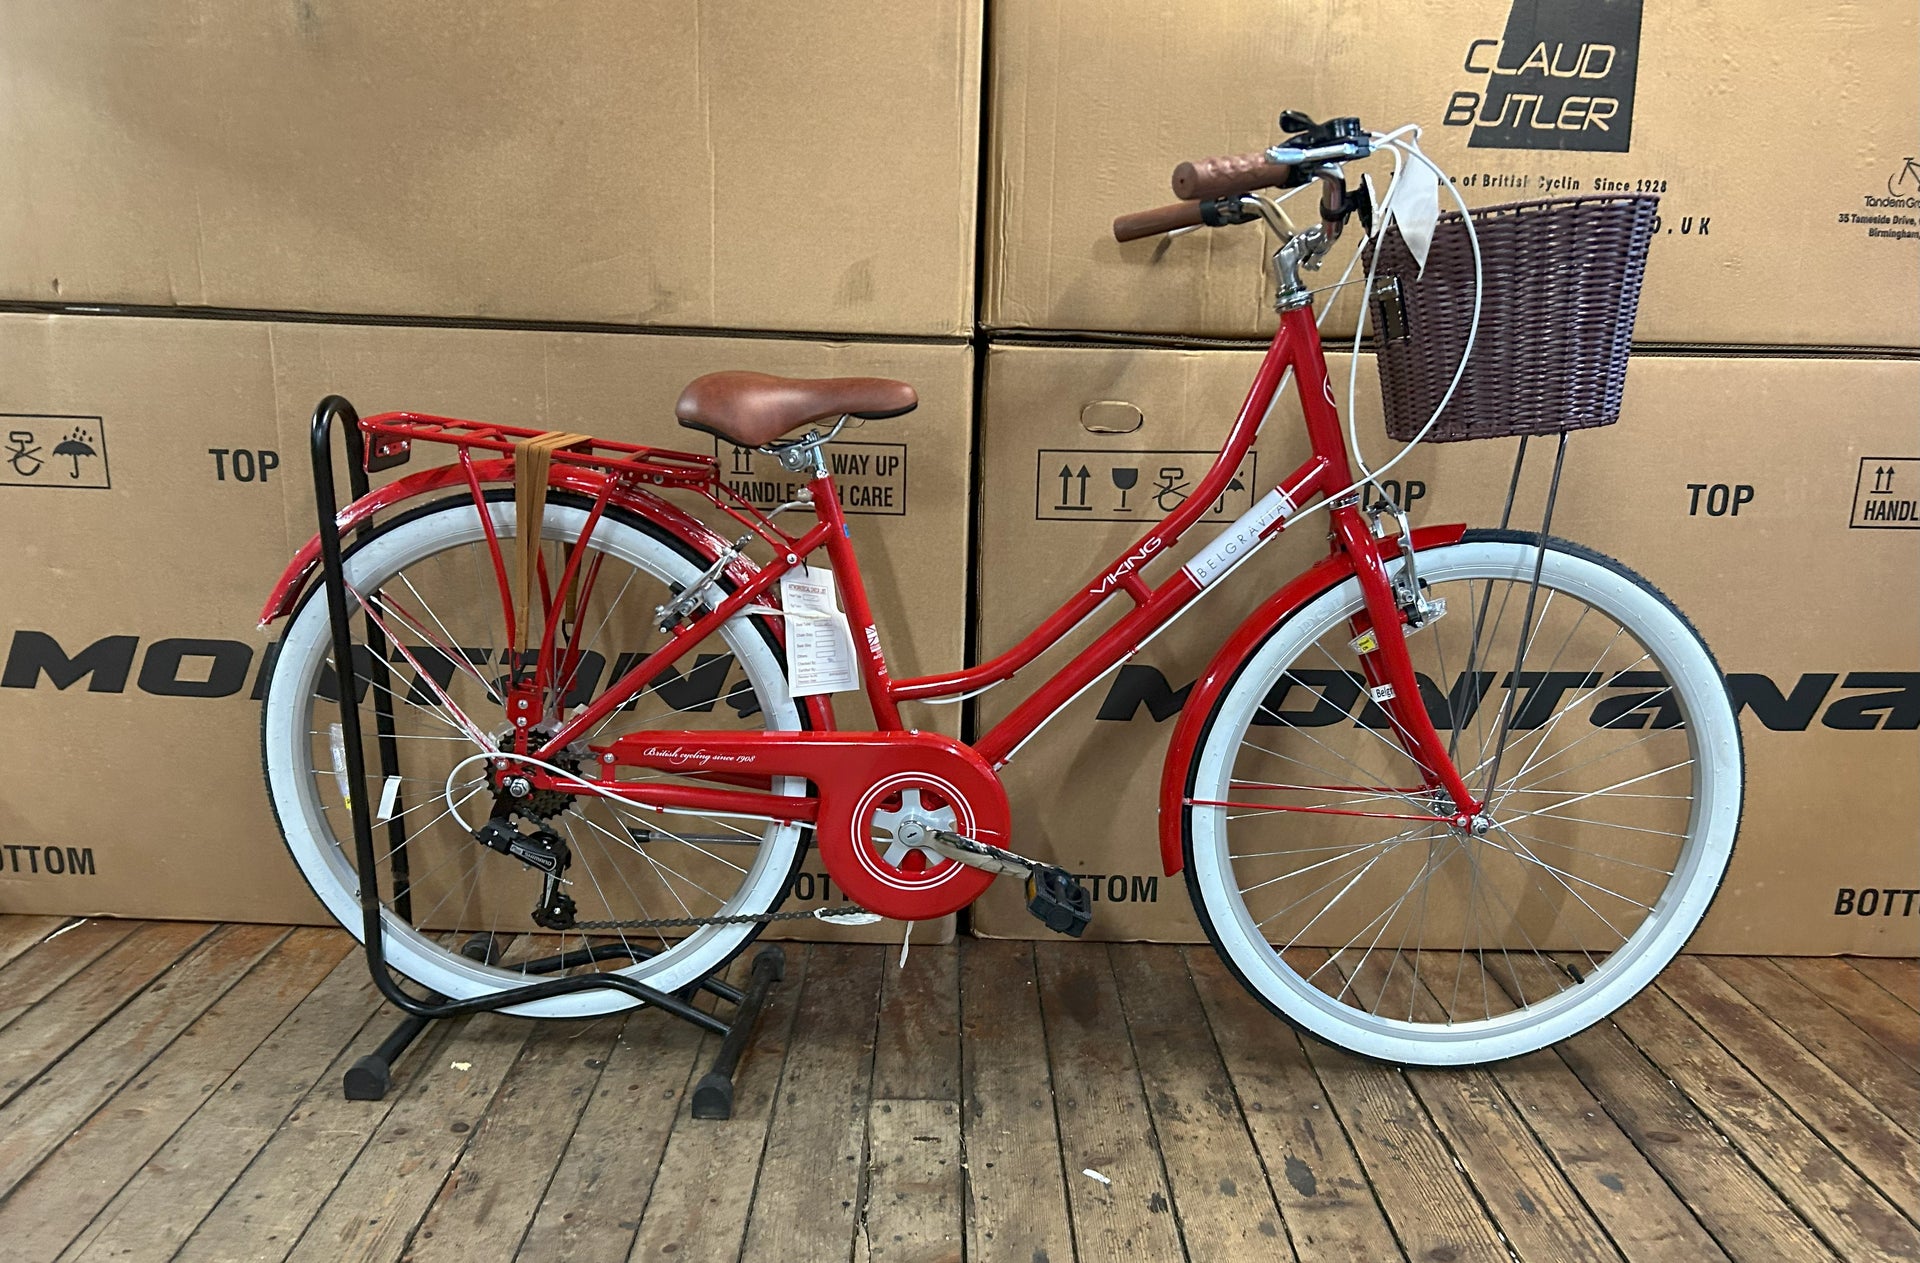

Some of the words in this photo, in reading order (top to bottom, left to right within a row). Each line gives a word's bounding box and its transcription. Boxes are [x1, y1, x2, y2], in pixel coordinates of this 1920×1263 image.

[1464, 39, 1616, 79] CLAUD
[1442, 91, 1619, 132] BUTLER
[1463, 173, 1477, 187] of
[1594, 177, 1630, 191] Since
[1636, 179, 1668, 193] 1928
[1864, 195, 1905, 208] Tandem
[1838, 213, 1850, 223] 35
[1851, 213, 1891, 225] Tameside
[1892, 215, 1917, 227] Drive,
[208, 448, 280, 483] TOP
[831, 453, 870, 476] WAY
[876, 456, 899, 477] UP
[728, 480, 796, 503] HANDLE
[850, 486, 894, 507] CARE
[1686, 483, 1755, 517] TOP
[1863, 500, 1920, 521] HANDL
[1196, 503, 1286, 579] BELGRAVIA
[1089, 536, 1163, 595] VIKING
[643, 746, 684, 757] British
[669, 748, 711, 766] cycling
[712, 753, 735, 762] since
[0, 844, 96, 875] TTOM
[1834, 888, 1920, 917] BOTT
